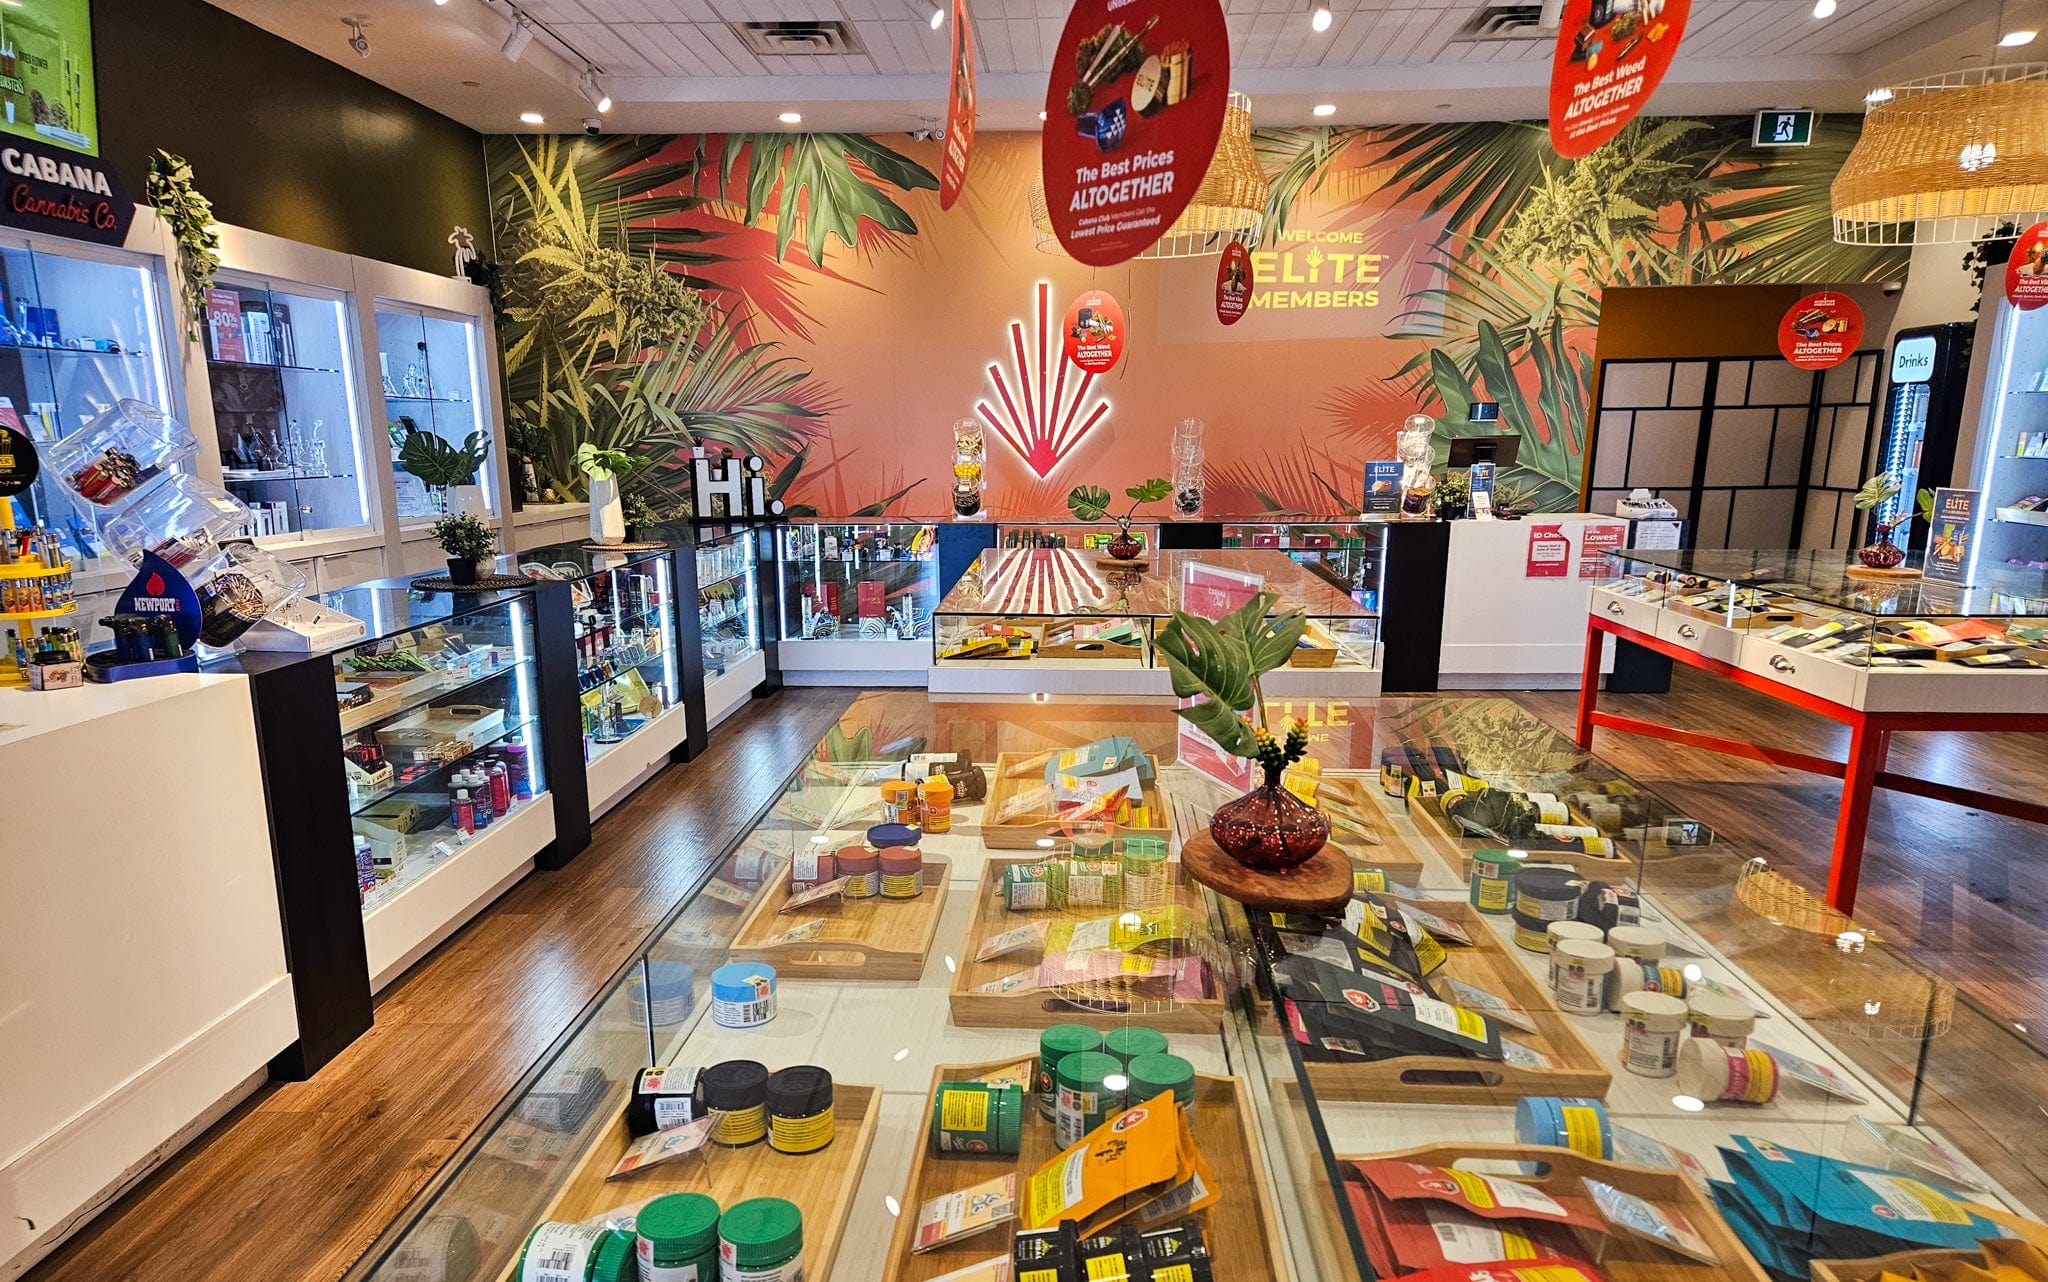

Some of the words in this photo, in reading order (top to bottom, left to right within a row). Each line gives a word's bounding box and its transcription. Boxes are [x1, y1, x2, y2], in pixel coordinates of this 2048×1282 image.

[1574, 81, 1590, 97] The
[1592, 70, 1614, 90] Best
[1616, 56, 1646, 80] Weed
[1564, 75, 1643, 121] ALTOGETHER
[1, 148, 113, 197] CABANA
[1076, 167, 1098, 184] The
[1101, 160, 1129, 178] Best
[1133, 150, 1174, 170] Prices
[1070, 171, 1174, 211] ALTOGETHER
[12, 184, 90, 223] Cannabis
[95, 203, 117, 230] Co.
[1071, 227, 1096, 239] Lowest
[1097, 224, 1115, 234] Price
[1116, 214, 1161, 231] Guaranteed
[1278, 229, 1364, 244] WELCOME
[1249, 290, 1379, 309] MEMBERS
[2014, 285, 2048, 293] ALTOGETHE
[1899, 355, 1928, 369] Drinks
[690, 455, 785, 517] Hi.
[1585, 533, 1618, 541] Lowest
[134, 597, 175, 612] NEWPORT
[1034, 1238, 1043, 1260] TRIBAL
